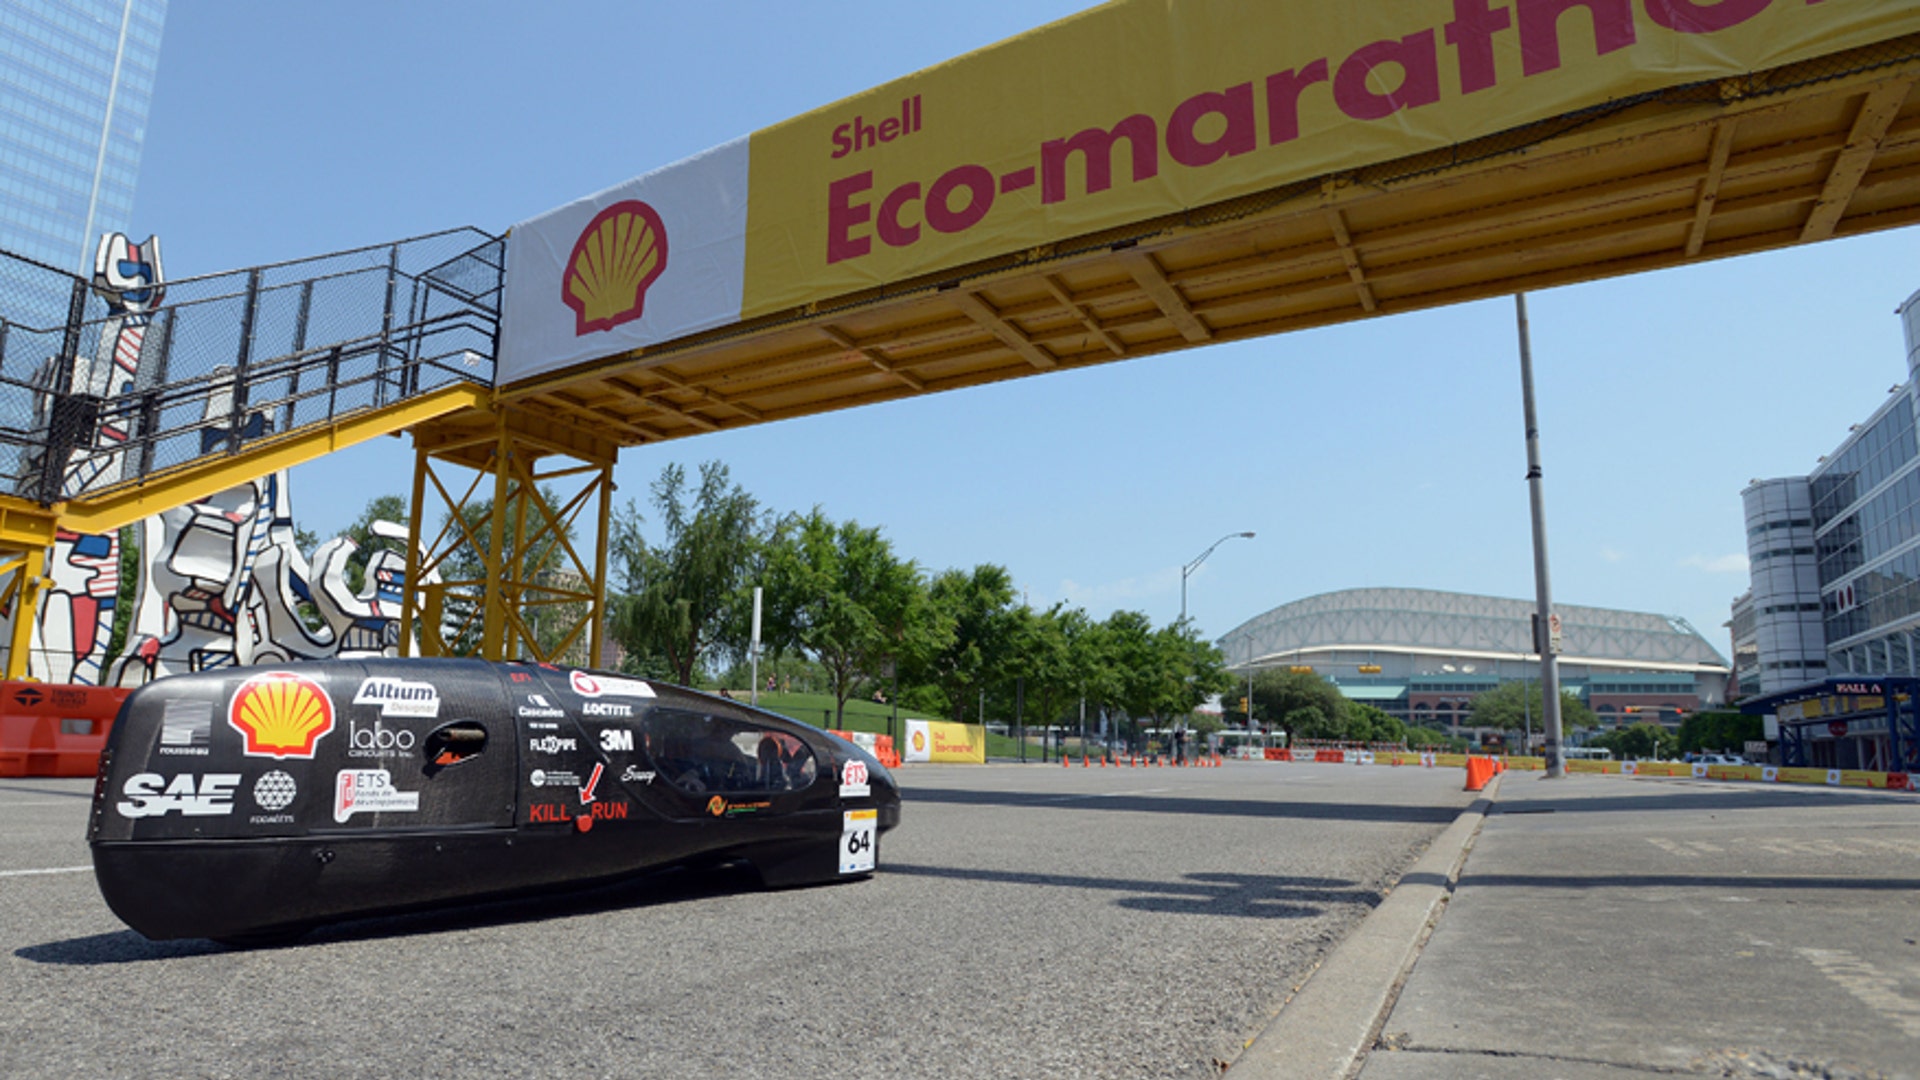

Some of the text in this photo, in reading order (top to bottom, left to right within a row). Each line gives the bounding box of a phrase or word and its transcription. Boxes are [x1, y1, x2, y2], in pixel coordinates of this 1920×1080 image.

[826, 0, 1824, 266] Eco-marath
[830, 94, 922, 159] Shell
[362, 682, 433, 700] Altium
[1871, 683, 1882, 694] A
[583, 703, 634, 716] LOCTITE
[349, 720, 415, 749] labo
[600, 730, 634, 751] 3M
[357, 772, 385, 787] ÉTS
[116, 773, 242, 817] SAE
[529, 804, 571, 822] KILL
[591, 802, 628, 819] RUN
[848, 830, 870, 854] 64
